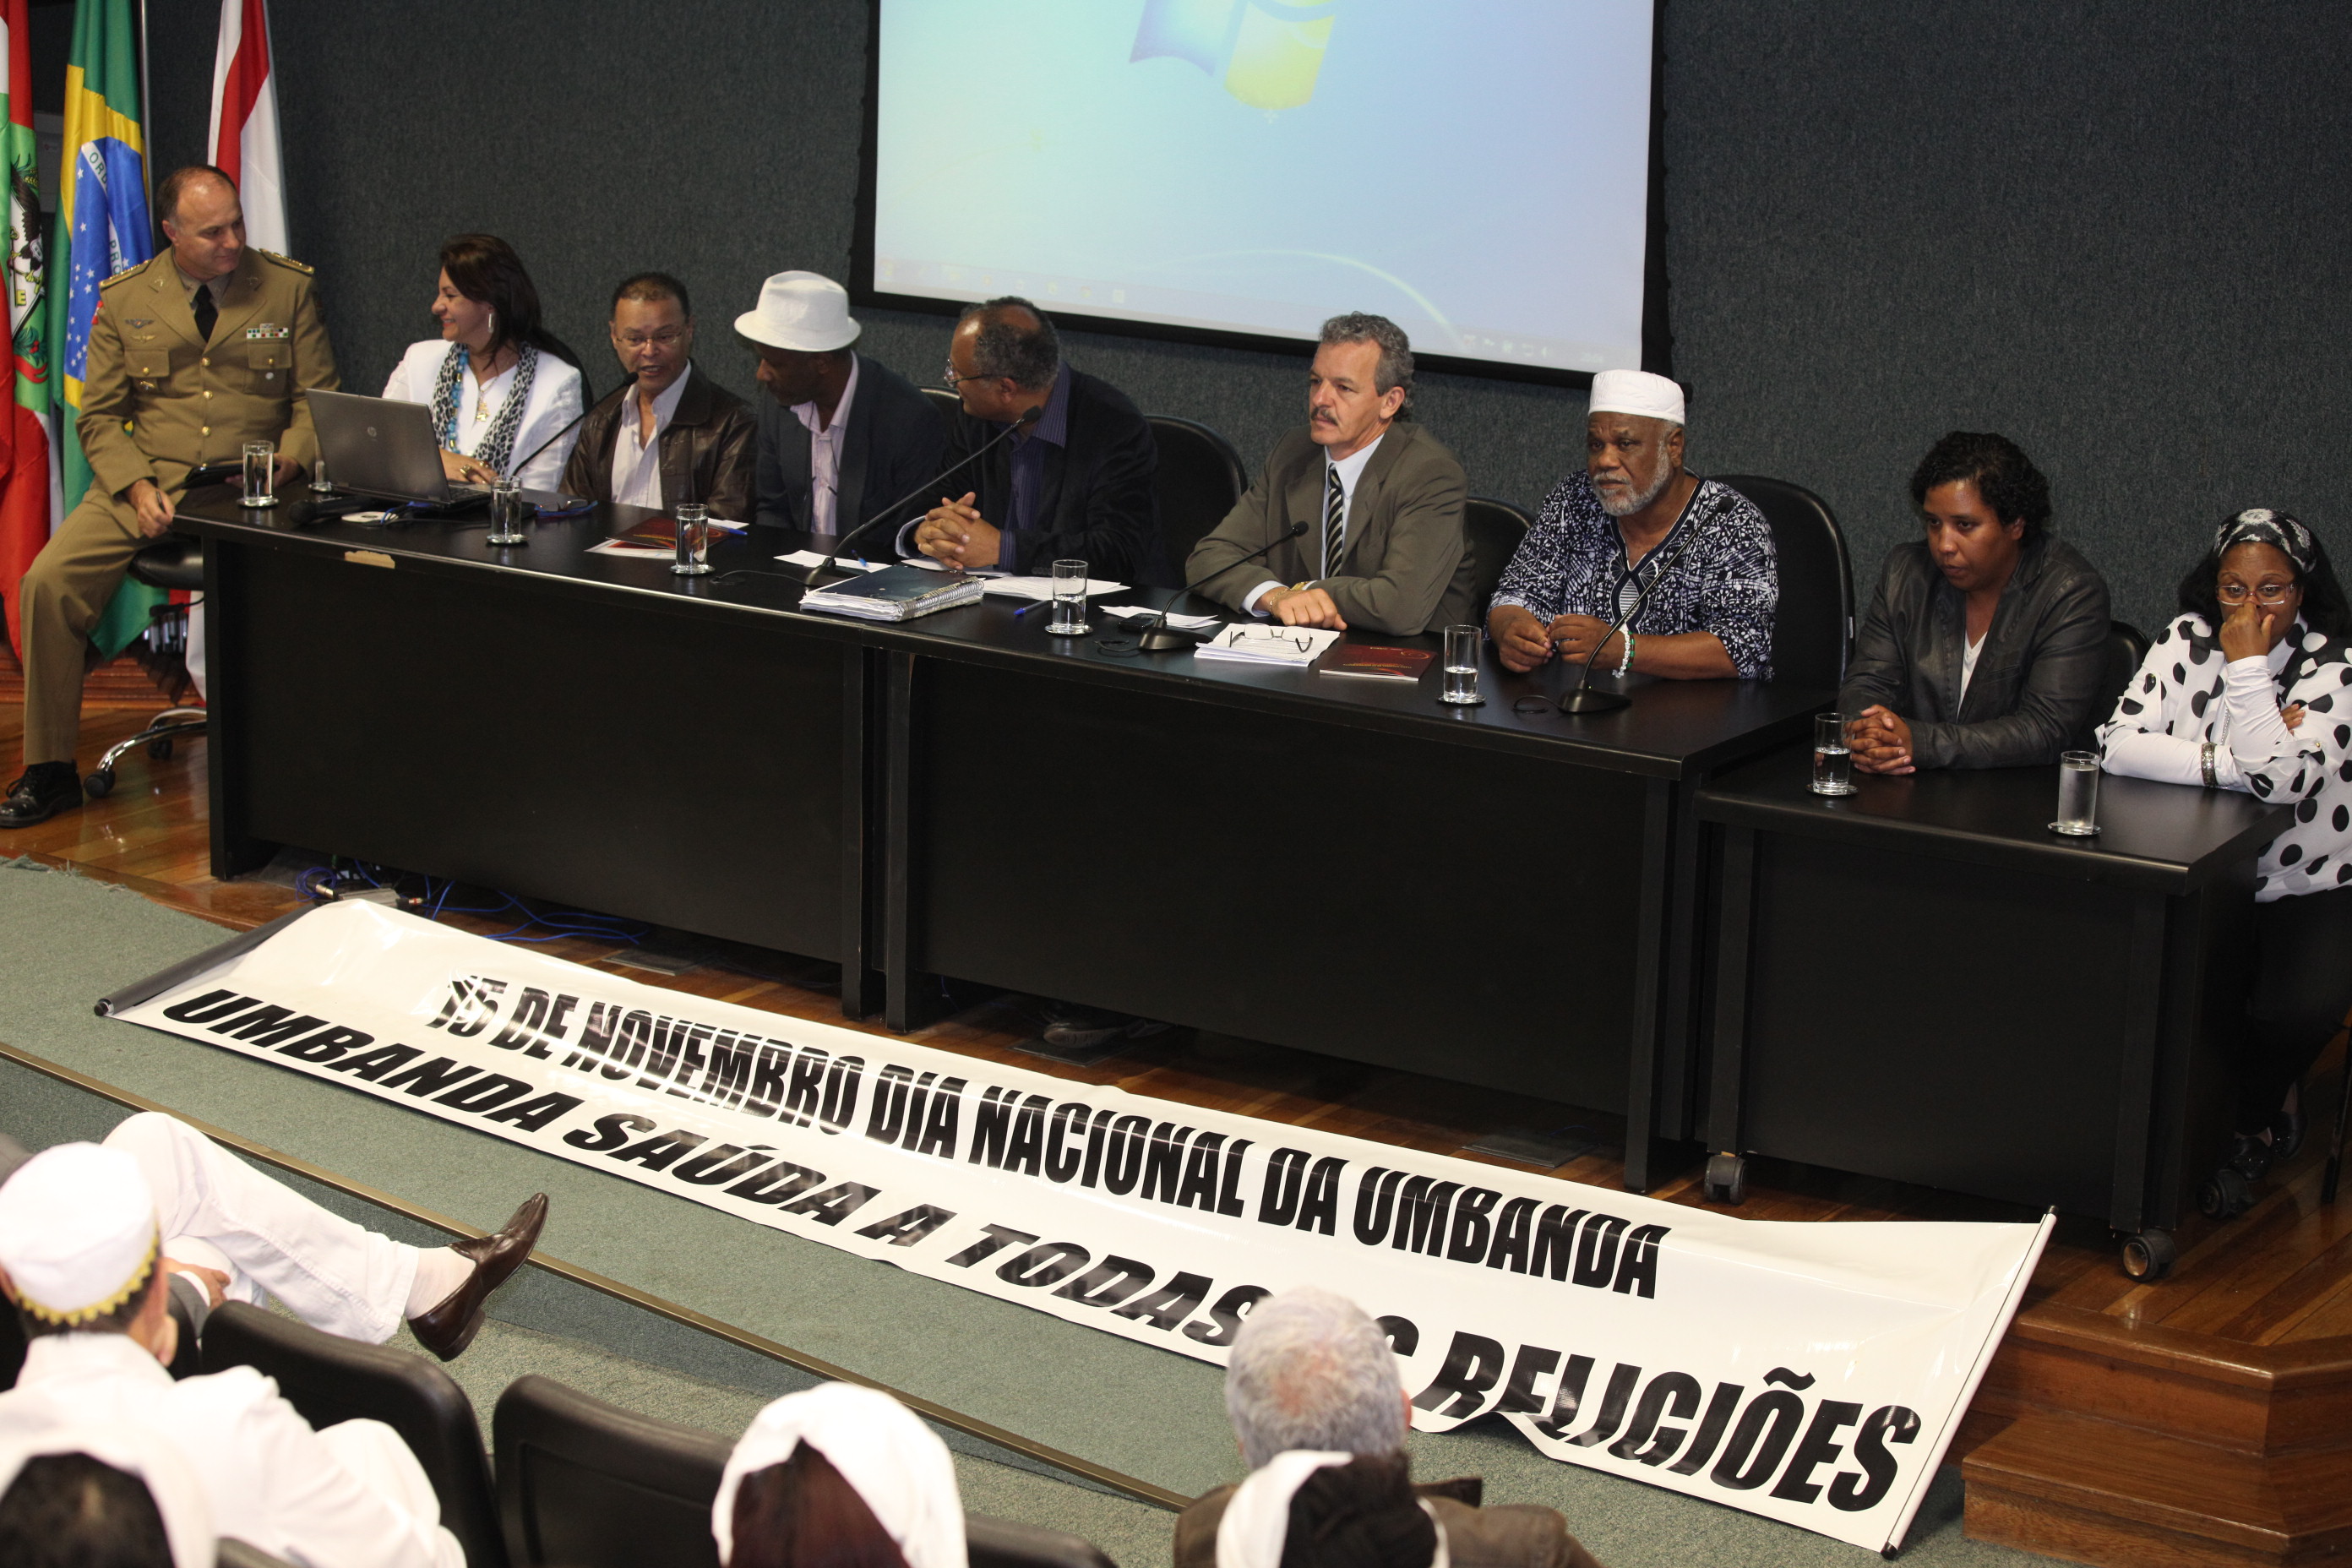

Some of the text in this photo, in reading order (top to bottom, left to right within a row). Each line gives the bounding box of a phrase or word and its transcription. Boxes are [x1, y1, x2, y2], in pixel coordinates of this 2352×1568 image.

[162, 988, 1922, 1512] UMBANDA SAÚDA A TODAS RELIGIÕES
[425, 975, 1672, 1299] 15 DE NOVEMBRO DIA NACIONAL DA UMBANDA
